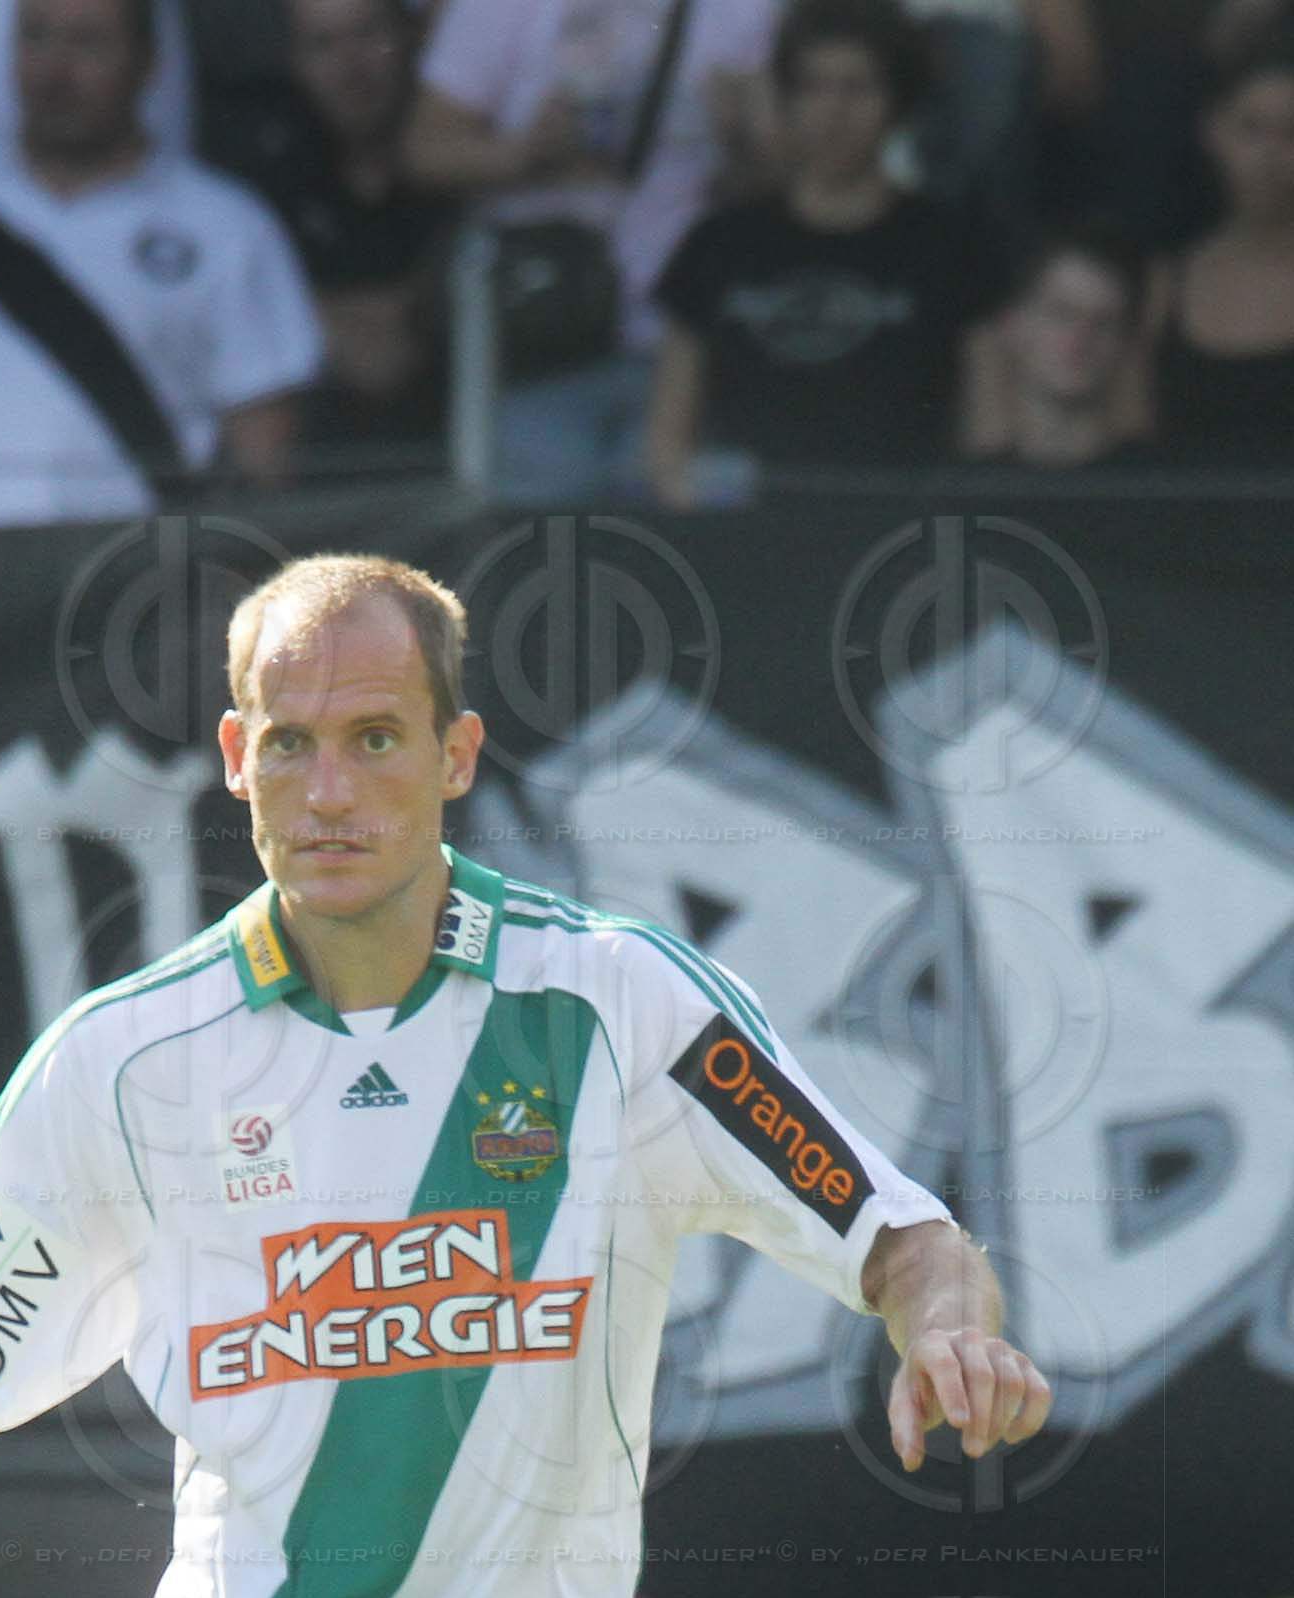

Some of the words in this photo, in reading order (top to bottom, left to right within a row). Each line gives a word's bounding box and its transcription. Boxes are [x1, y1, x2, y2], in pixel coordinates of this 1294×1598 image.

[464, 903, 488, 959] OMV
[704, 1039, 854, 1206] Orange
[224, 1159, 291, 1182] BUNDES
[225, 1173, 294, 1203] LIGA
[273, 1218, 501, 1299] WIEN
[197, 1290, 585, 1392] ENERGIE
